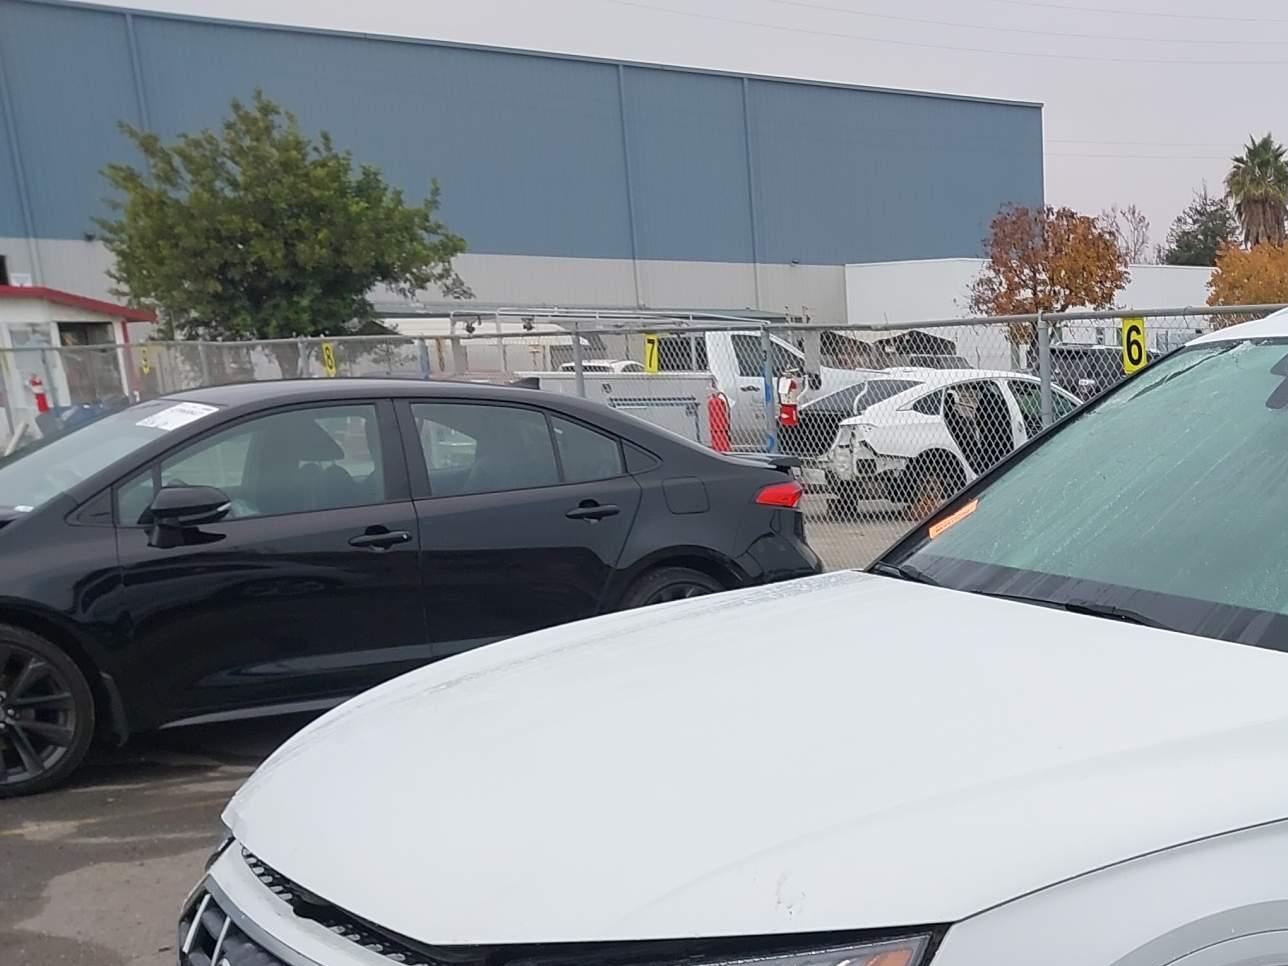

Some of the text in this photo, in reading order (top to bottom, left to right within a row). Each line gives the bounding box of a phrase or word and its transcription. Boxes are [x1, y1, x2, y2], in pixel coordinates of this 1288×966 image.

[323, 344, 334, 371] 8
[646, 338, 656, 369] 7
[1126, 324, 1143, 367] 6
